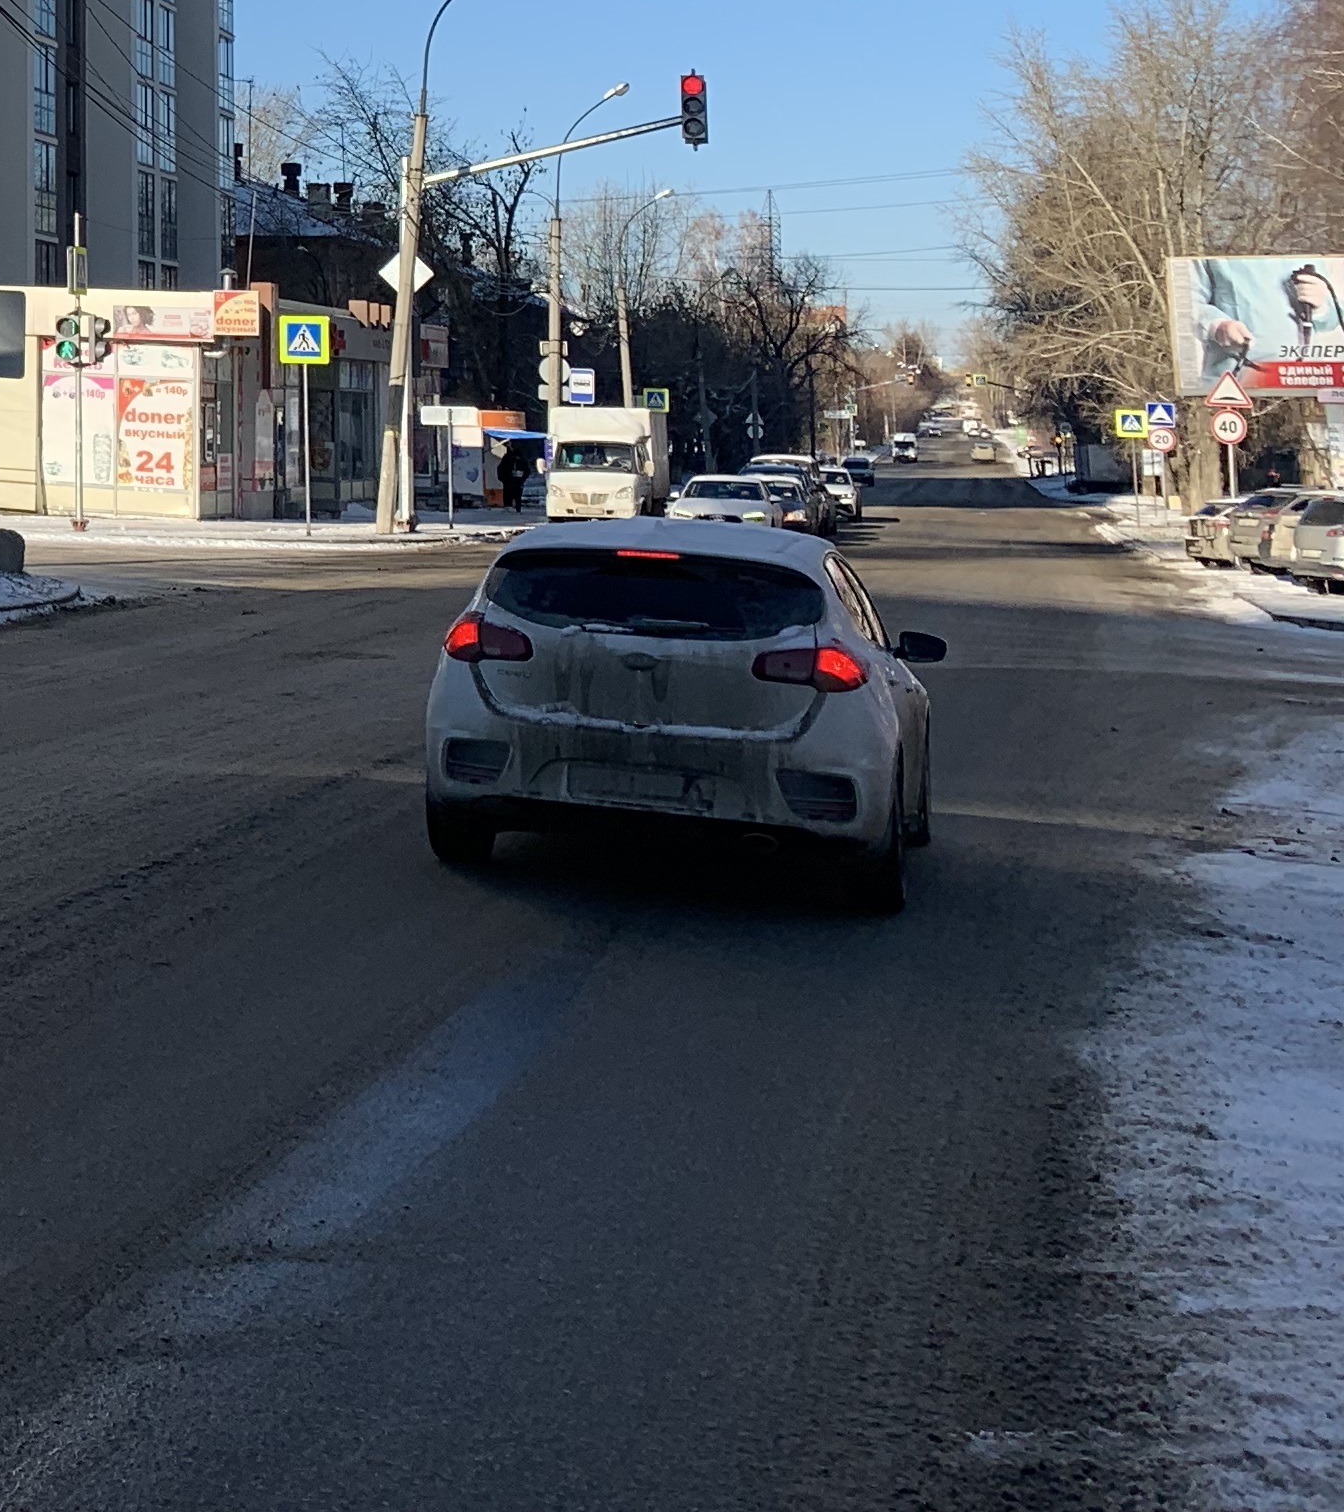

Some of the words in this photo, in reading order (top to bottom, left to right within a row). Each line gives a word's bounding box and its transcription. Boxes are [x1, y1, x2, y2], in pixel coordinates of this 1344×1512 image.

[215, 316, 257, 326] doner
[1278, 365, 1333, 377] единый
[1279, 376, 1334, 387] телефон
[124, 408, 186, 426] doner
[1218, 420, 1238, 434] 40
[124, 428, 186, 441] вкусный
[1154, 434, 1170, 445] 20
[135, 450, 175, 474] 24
[135, 475, 175, 487] часа
